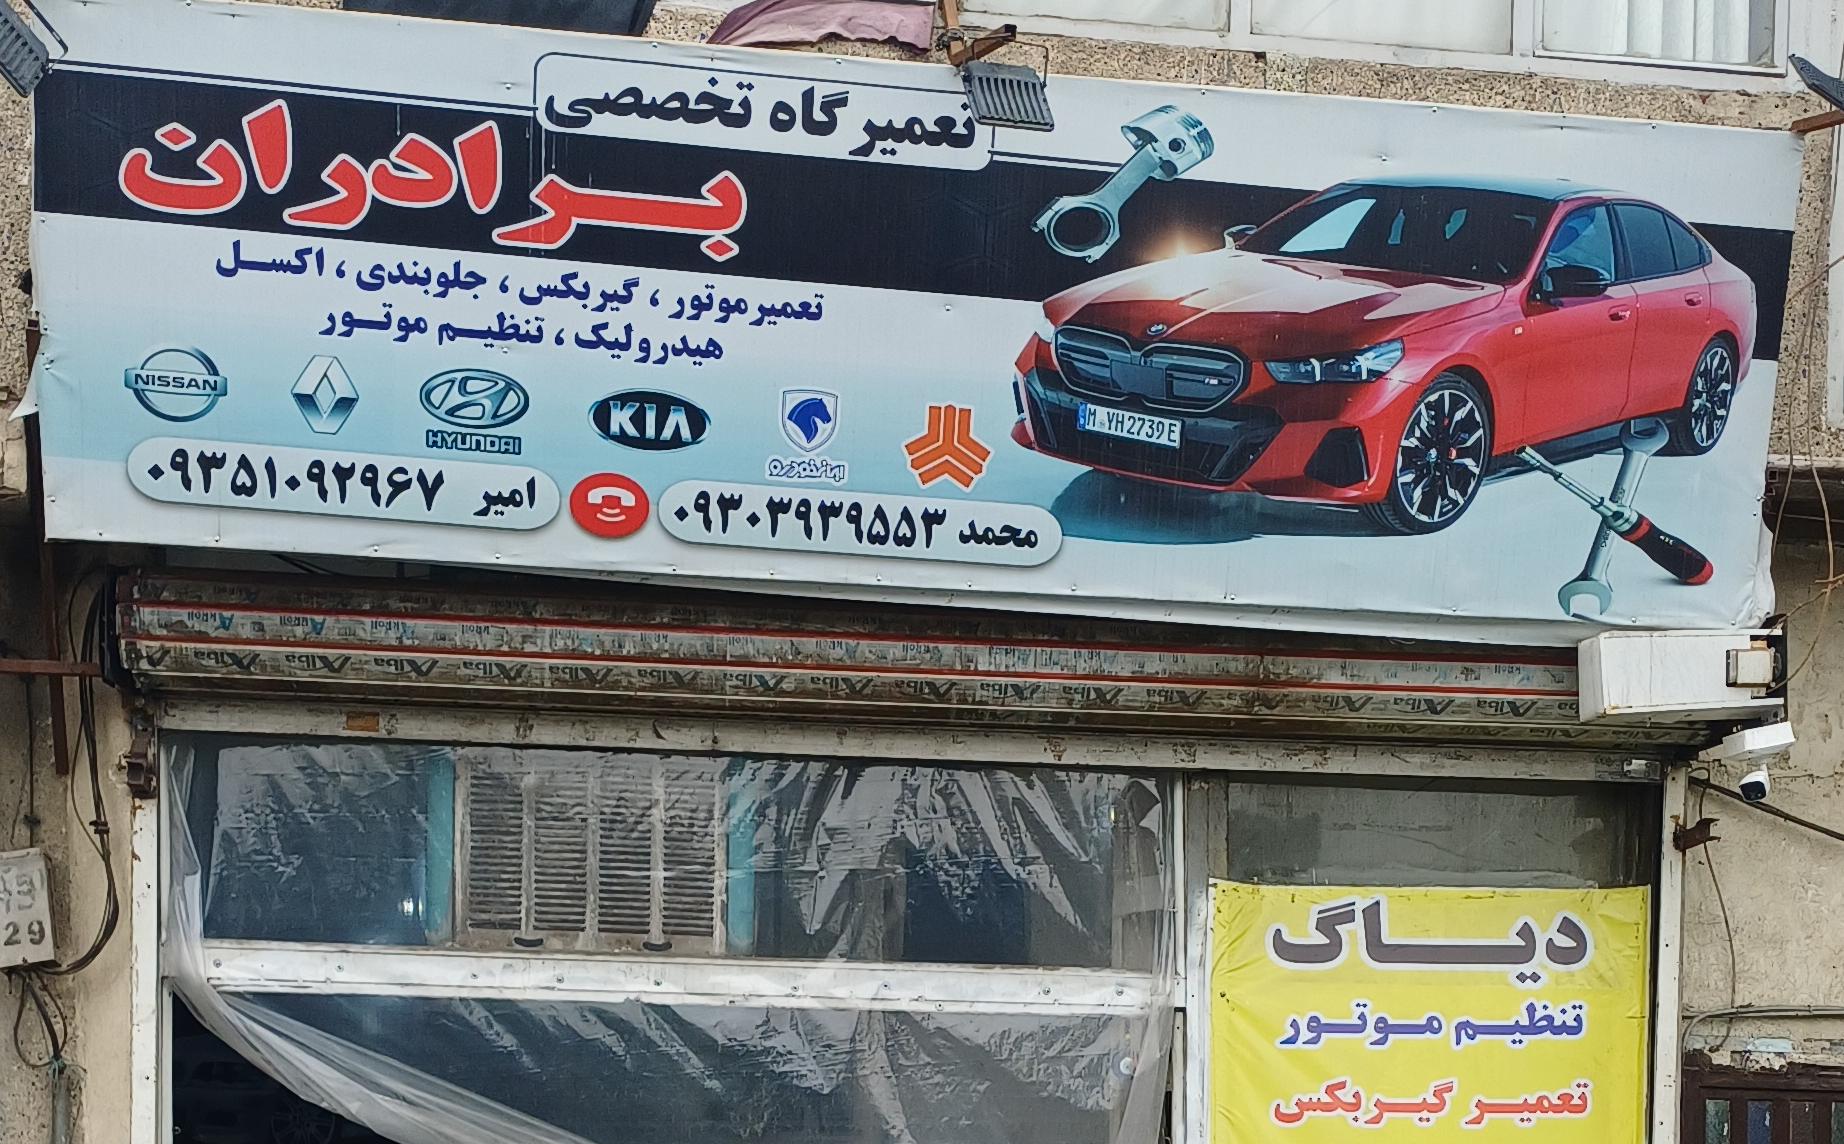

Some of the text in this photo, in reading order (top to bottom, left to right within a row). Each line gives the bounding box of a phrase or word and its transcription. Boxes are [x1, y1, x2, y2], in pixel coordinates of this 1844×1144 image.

[545, 77, 755, 129] تخصصی
[120, 103, 746, 260] برادران
[216, 240, 325, 278] اکسل
[356, 259, 487, 300] جلوبندی
[518, 271, 640, 312] گیربکس
[318, 302, 428, 343] موتور
[438, 310, 545, 349] تنظیم
[574, 322, 724, 367] هیدرولیک
[133, 371, 219, 393] NISSAN
[425, 430, 522, 456] HYUNDAI
[609, 409, 693, 443] KIA
[146, 447, 537, 517] امیر ۰۹۳۵۱۰۹۲۹۶۷
[673, 491, 1039, 550] محمد ۰۹۳۰۳۹۳۹۵۵۳
[284, 653, 353, 674] Alba
[1393, 696, 1456, 716] Alba
[1475, 697, 1539, 717] Alba
[1273, 900, 1588, 984] دیاگ
[1279, 1002, 1584, 1046] تنظیم موتور
[1274, 1080, 1590, 1125] تعمیر گیربکس
